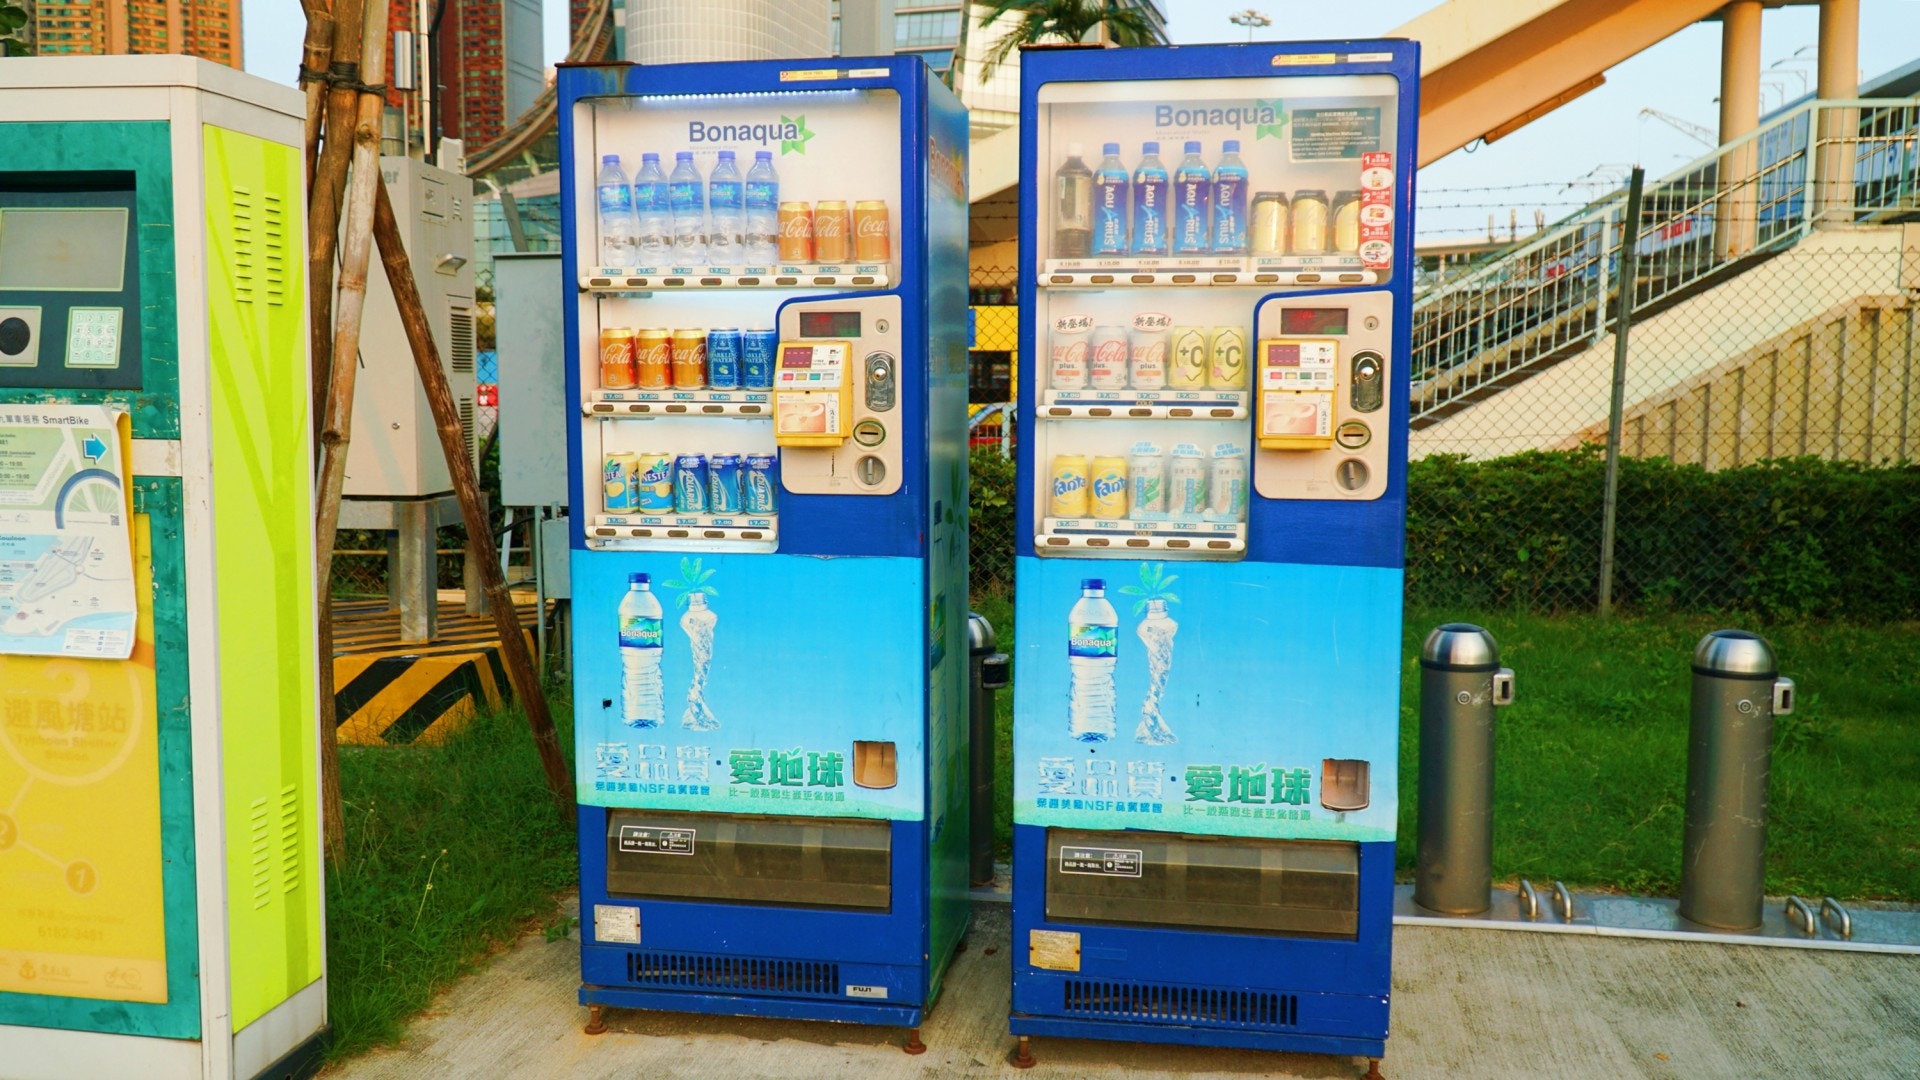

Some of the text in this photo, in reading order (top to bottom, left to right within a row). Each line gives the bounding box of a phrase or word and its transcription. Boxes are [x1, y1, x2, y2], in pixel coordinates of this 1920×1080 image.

[1154, 104, 1275, 132] Bonaqua
[689, 119, 798, 146] Bonaqua
[1363, 193, 1371, 201] 2
[1363, 228, 1370, 236] 3
[1215, 345, 1242, 368] +C
[42, 415, 89, 425] SmartBike
[1053, 475, 1086, 497] Fanta
[621, 629, 658, 639] Bonaqua
[1071, 638, 1111, 648] Bonaqua
[729, 747, 845, 788] 愛地球
[1184, 764, 1312, 806] 愛地球
